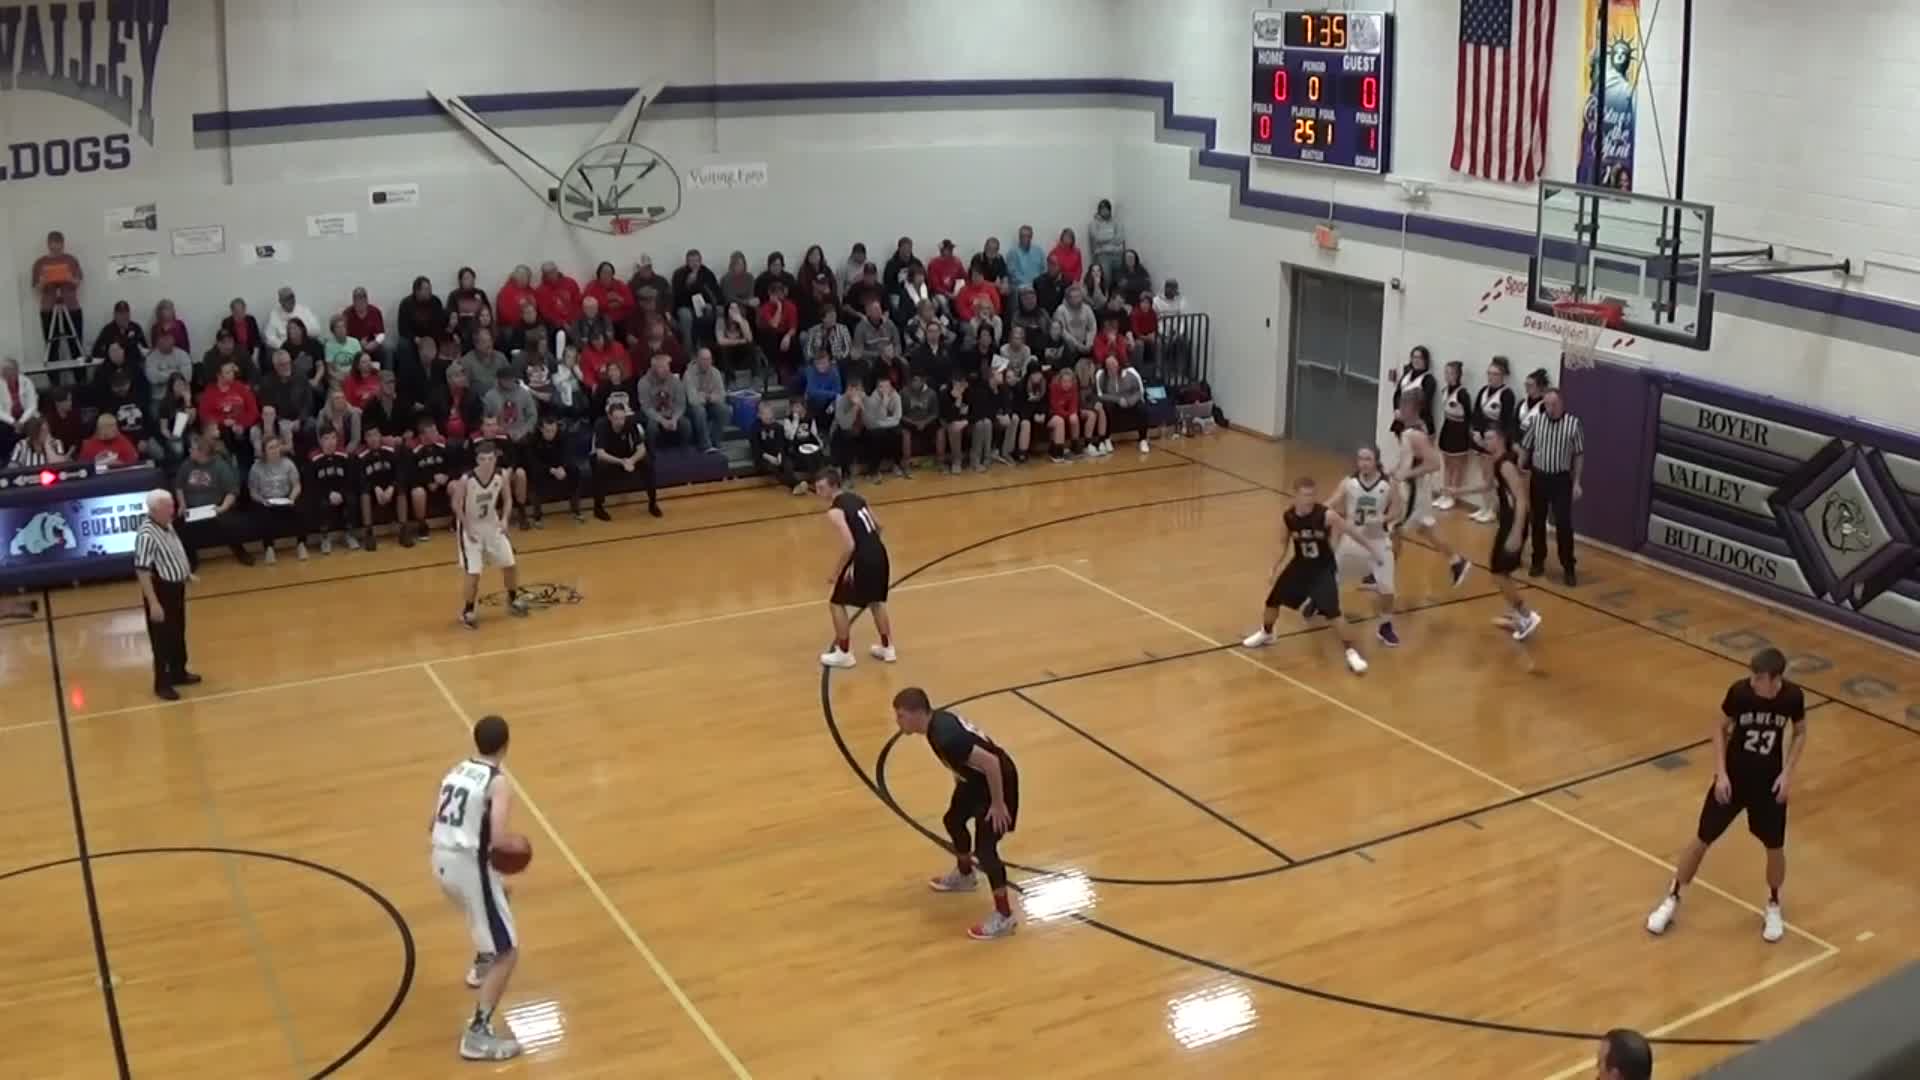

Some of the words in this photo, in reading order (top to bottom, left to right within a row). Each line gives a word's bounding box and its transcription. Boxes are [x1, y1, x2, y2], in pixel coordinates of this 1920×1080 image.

[1258, 50, 1285, 66] HOME
[1343, 55, 1376, 71] GUEST
[1274, 70, 1288, 101] 0
[1308, 75, 1320, 101] 0
[1362, 76, 1377, 109] 0
[1260, 116, 1271, 139] 0
[1293, 119, 1316, 145] 25
[0, 134, 131, 182] DOGS
[1697, 407, 1769, 447] BOYER
[1667, 462, 1747, 505] VALLEY
[857, 506, 877, 534] 11
[1663, 525, 1779, 580] BULLDOGS
[1743, 728, 1777, 756] 23
[438, 783, 470, 828] 23
